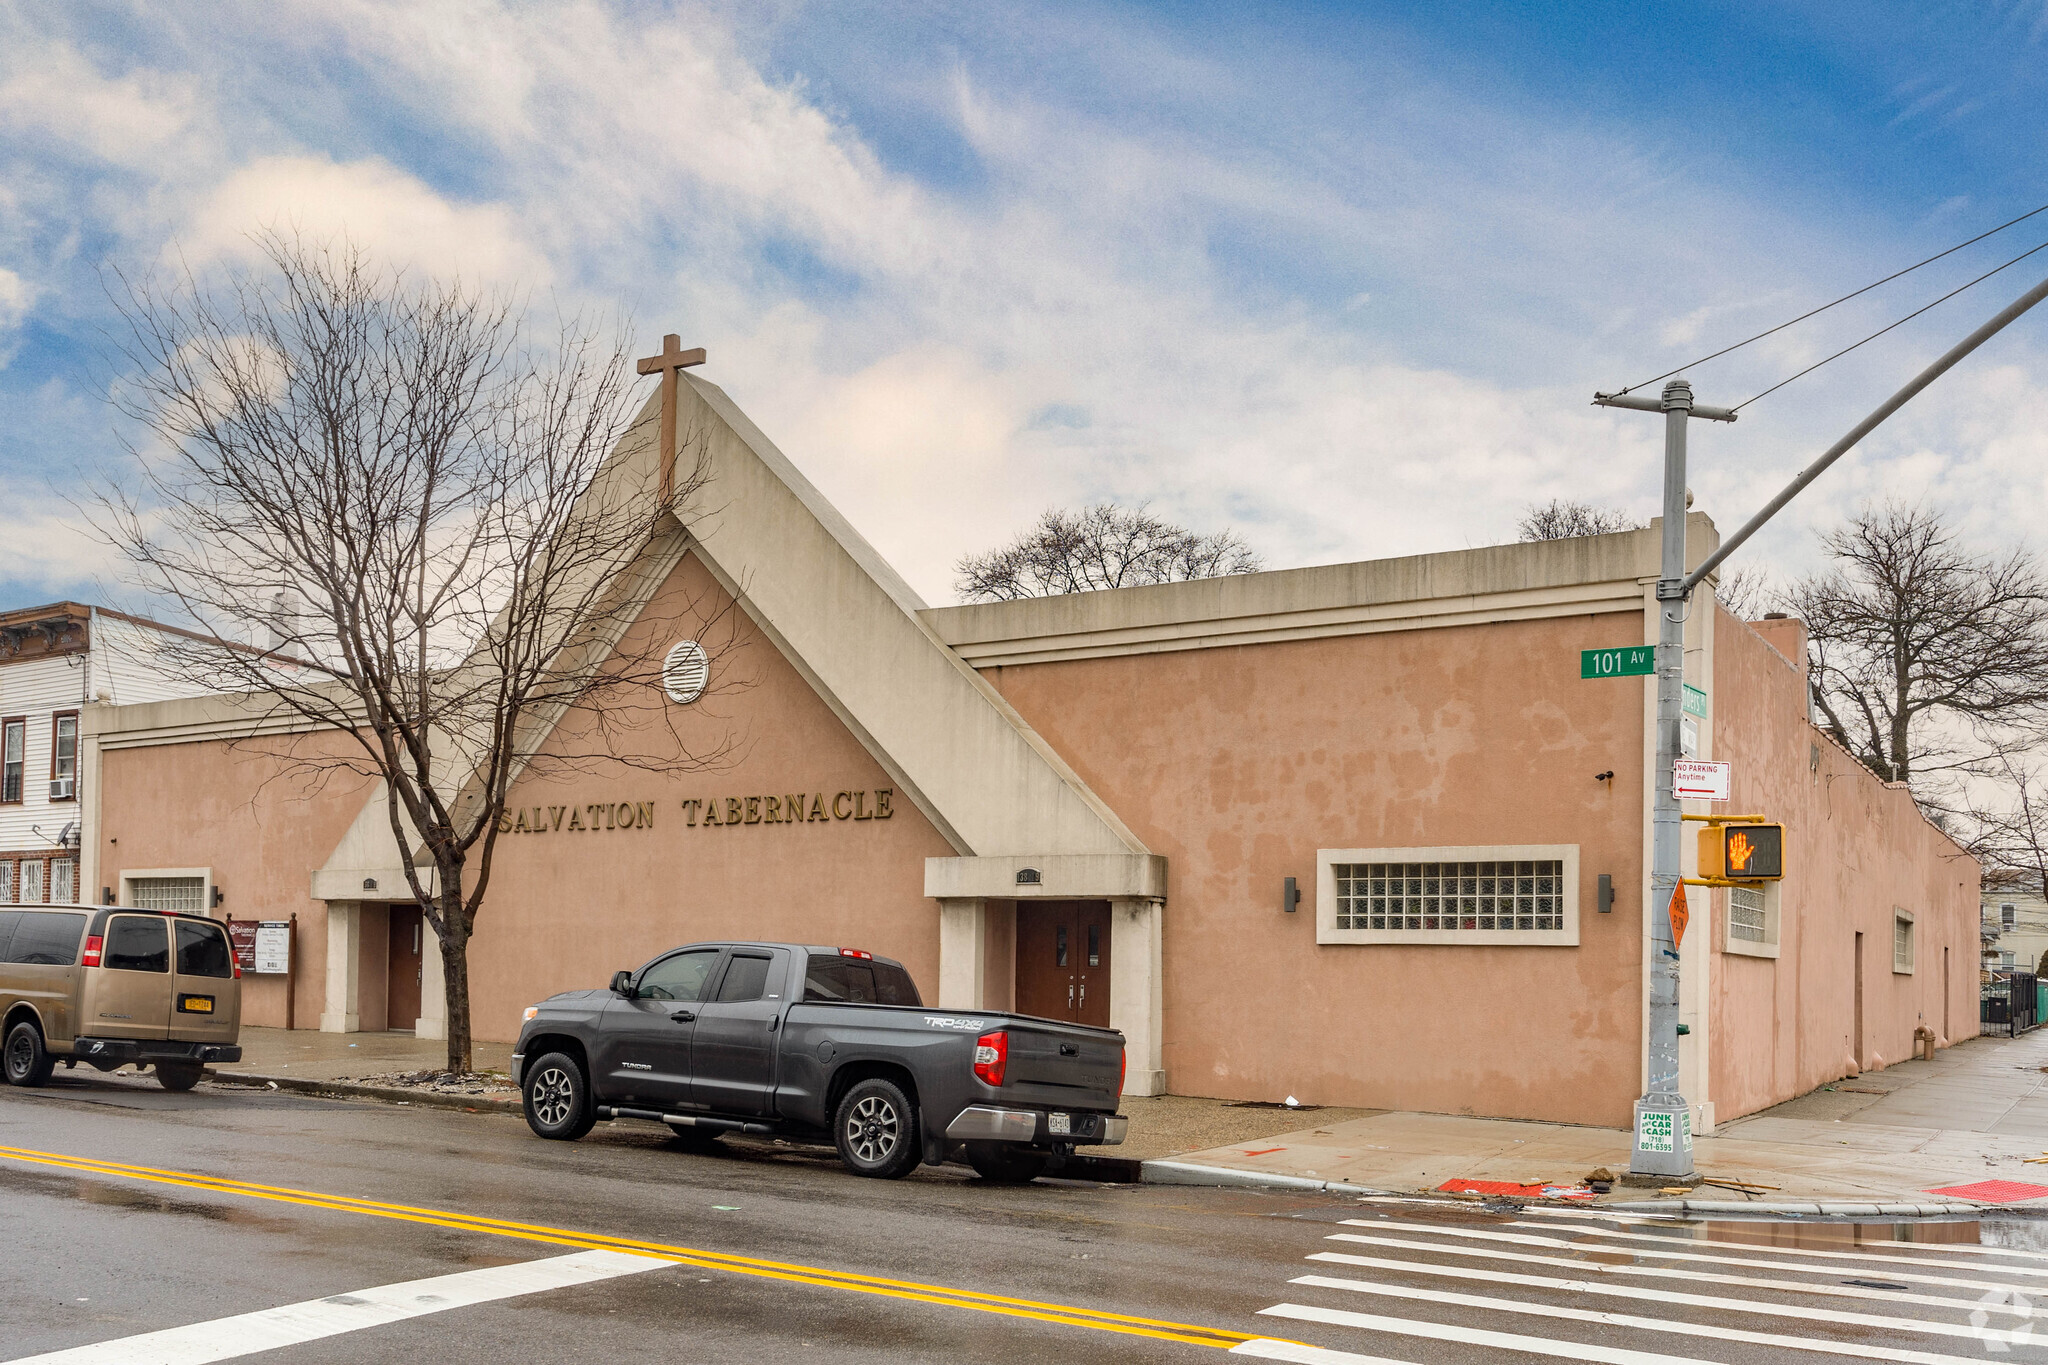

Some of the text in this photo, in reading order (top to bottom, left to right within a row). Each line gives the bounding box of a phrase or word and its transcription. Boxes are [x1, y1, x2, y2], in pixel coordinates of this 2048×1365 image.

[1593, 651, 1645, 674] 101 Av
[1682, 688, 1700, 712] nders
[1677, 764, 1718, 773] NO PARKING
[1677, 773, 1706, 781] Anytime
[499, 788, 894, 833] SALVATION TABERNACLE
[924, 1016, 955, 1028] TRD
[622, 1062, 652, 1071] TUNDRA
[1643, 1113, 1672, 1121] JUNK
[1641, 1142, 1672, 1151] 801-6395
